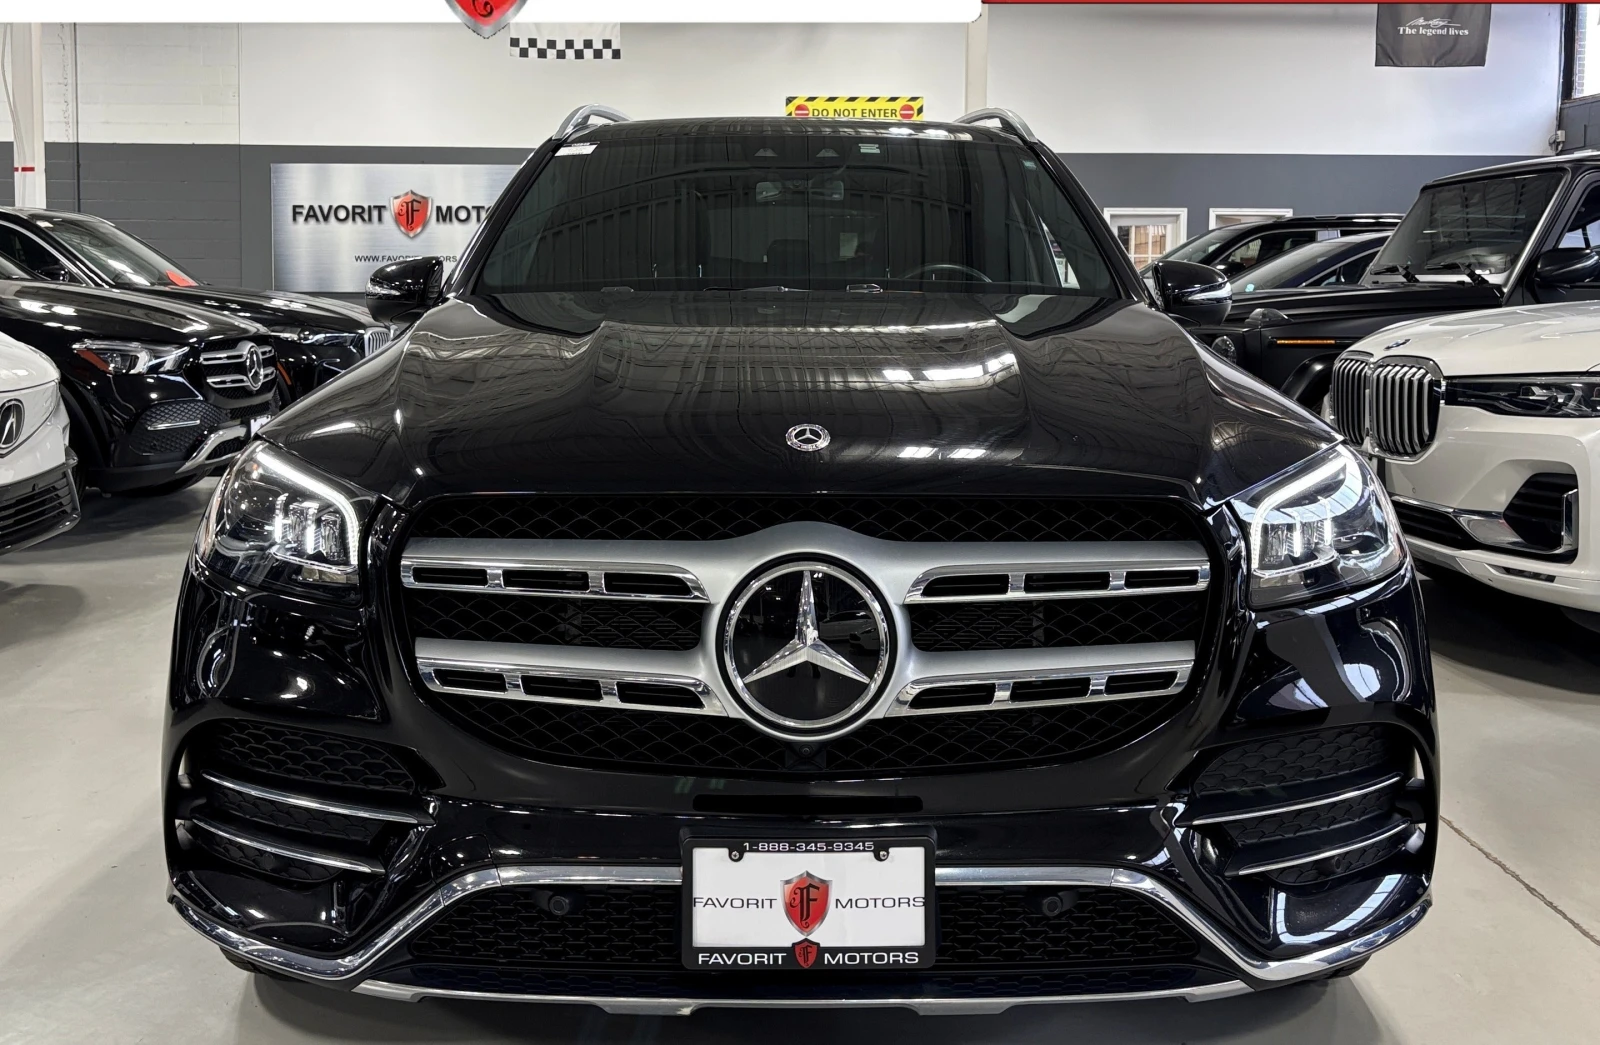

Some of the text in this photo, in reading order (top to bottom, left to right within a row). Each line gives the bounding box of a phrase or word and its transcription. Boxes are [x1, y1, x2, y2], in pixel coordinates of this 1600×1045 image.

[1397, 26, 1469, 36] The legend lives
[811, 108, 898, 118] DO NOT ENTER
[291, 204, 387, 223] FAVORIT
[435, 205, 492, 223] MOT
[743, 842, 875, 852] 1-888-345-9345
[693, 897, 778, 909] FAVORIT
[835, 896, 926, 909] MOTORS
[698, 953, 787, 965] FAVORIT
[824, 952, 919, 965] MOTORS
